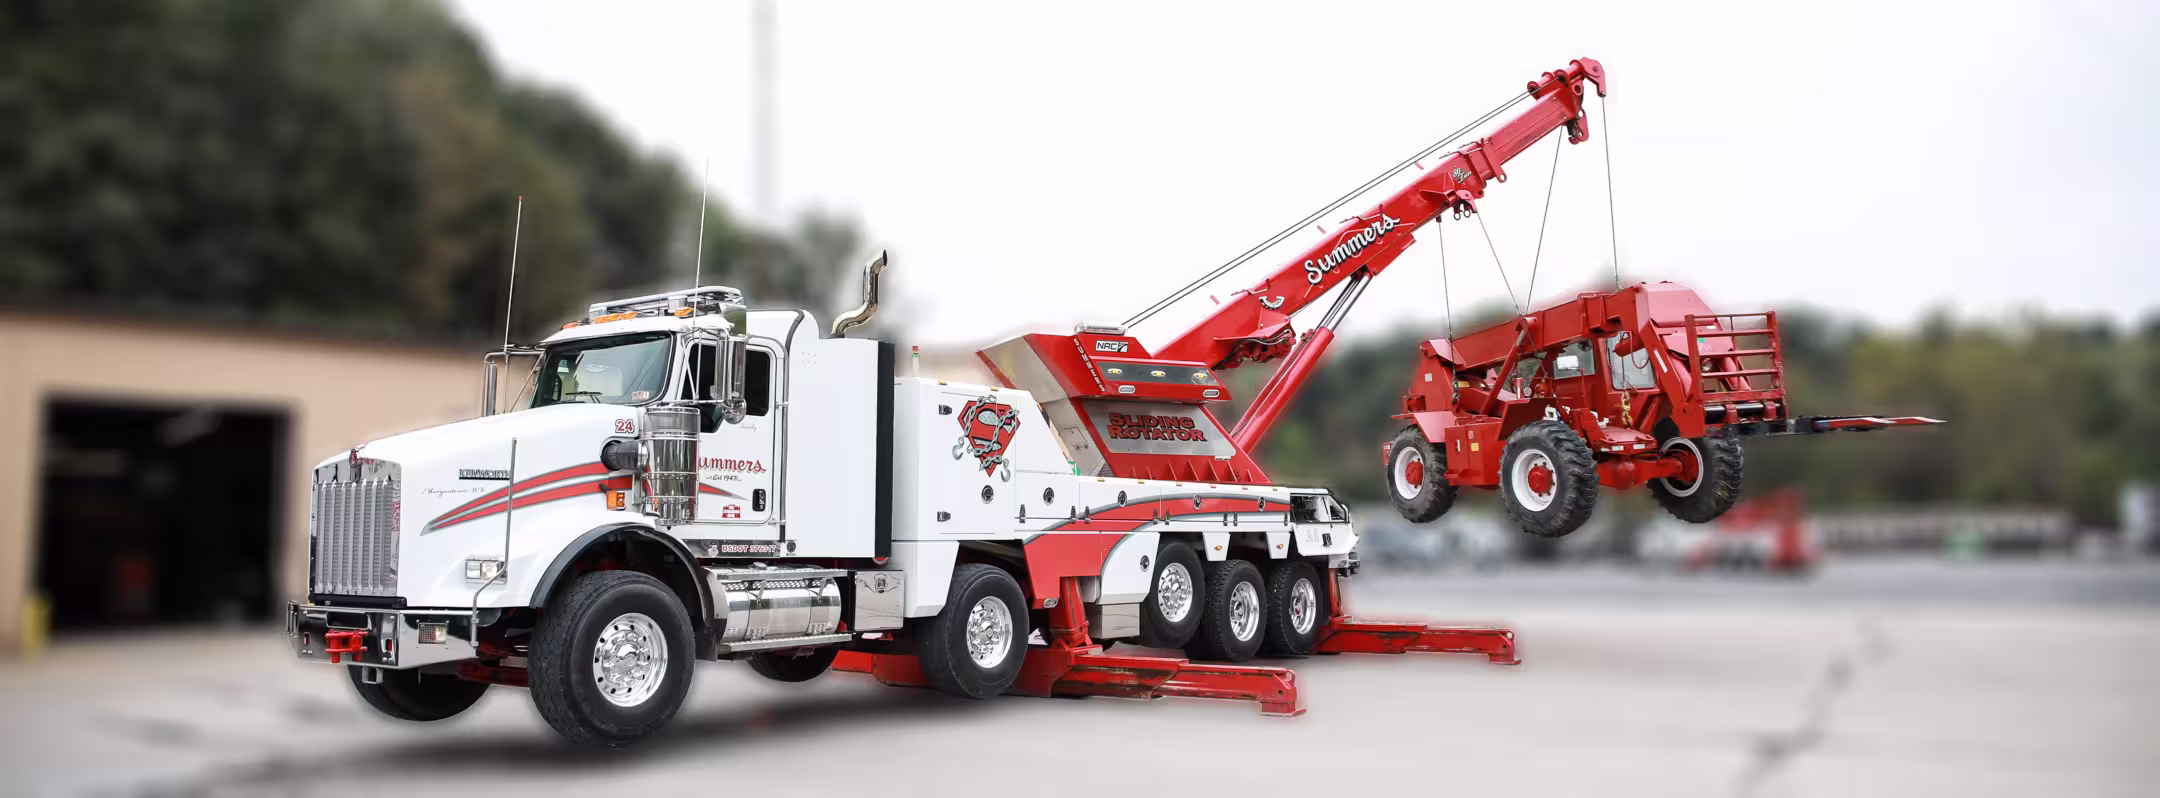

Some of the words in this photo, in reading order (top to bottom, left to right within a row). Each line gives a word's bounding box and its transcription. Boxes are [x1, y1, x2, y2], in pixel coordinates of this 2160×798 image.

[1304, 213, 1401, 284] Summers
[1096, 342, 1118, 351] NRC
[1073, 338, 1105, 392] SUMMERS
[615, 418, 635, 434] 24
[1108, 412, 1196, 429] SLIDING
[1106, 424, 1208, 442] ROTATOR
[698, 457, 767, 474] ummers
[721, 544, 749, 553] USDOT
